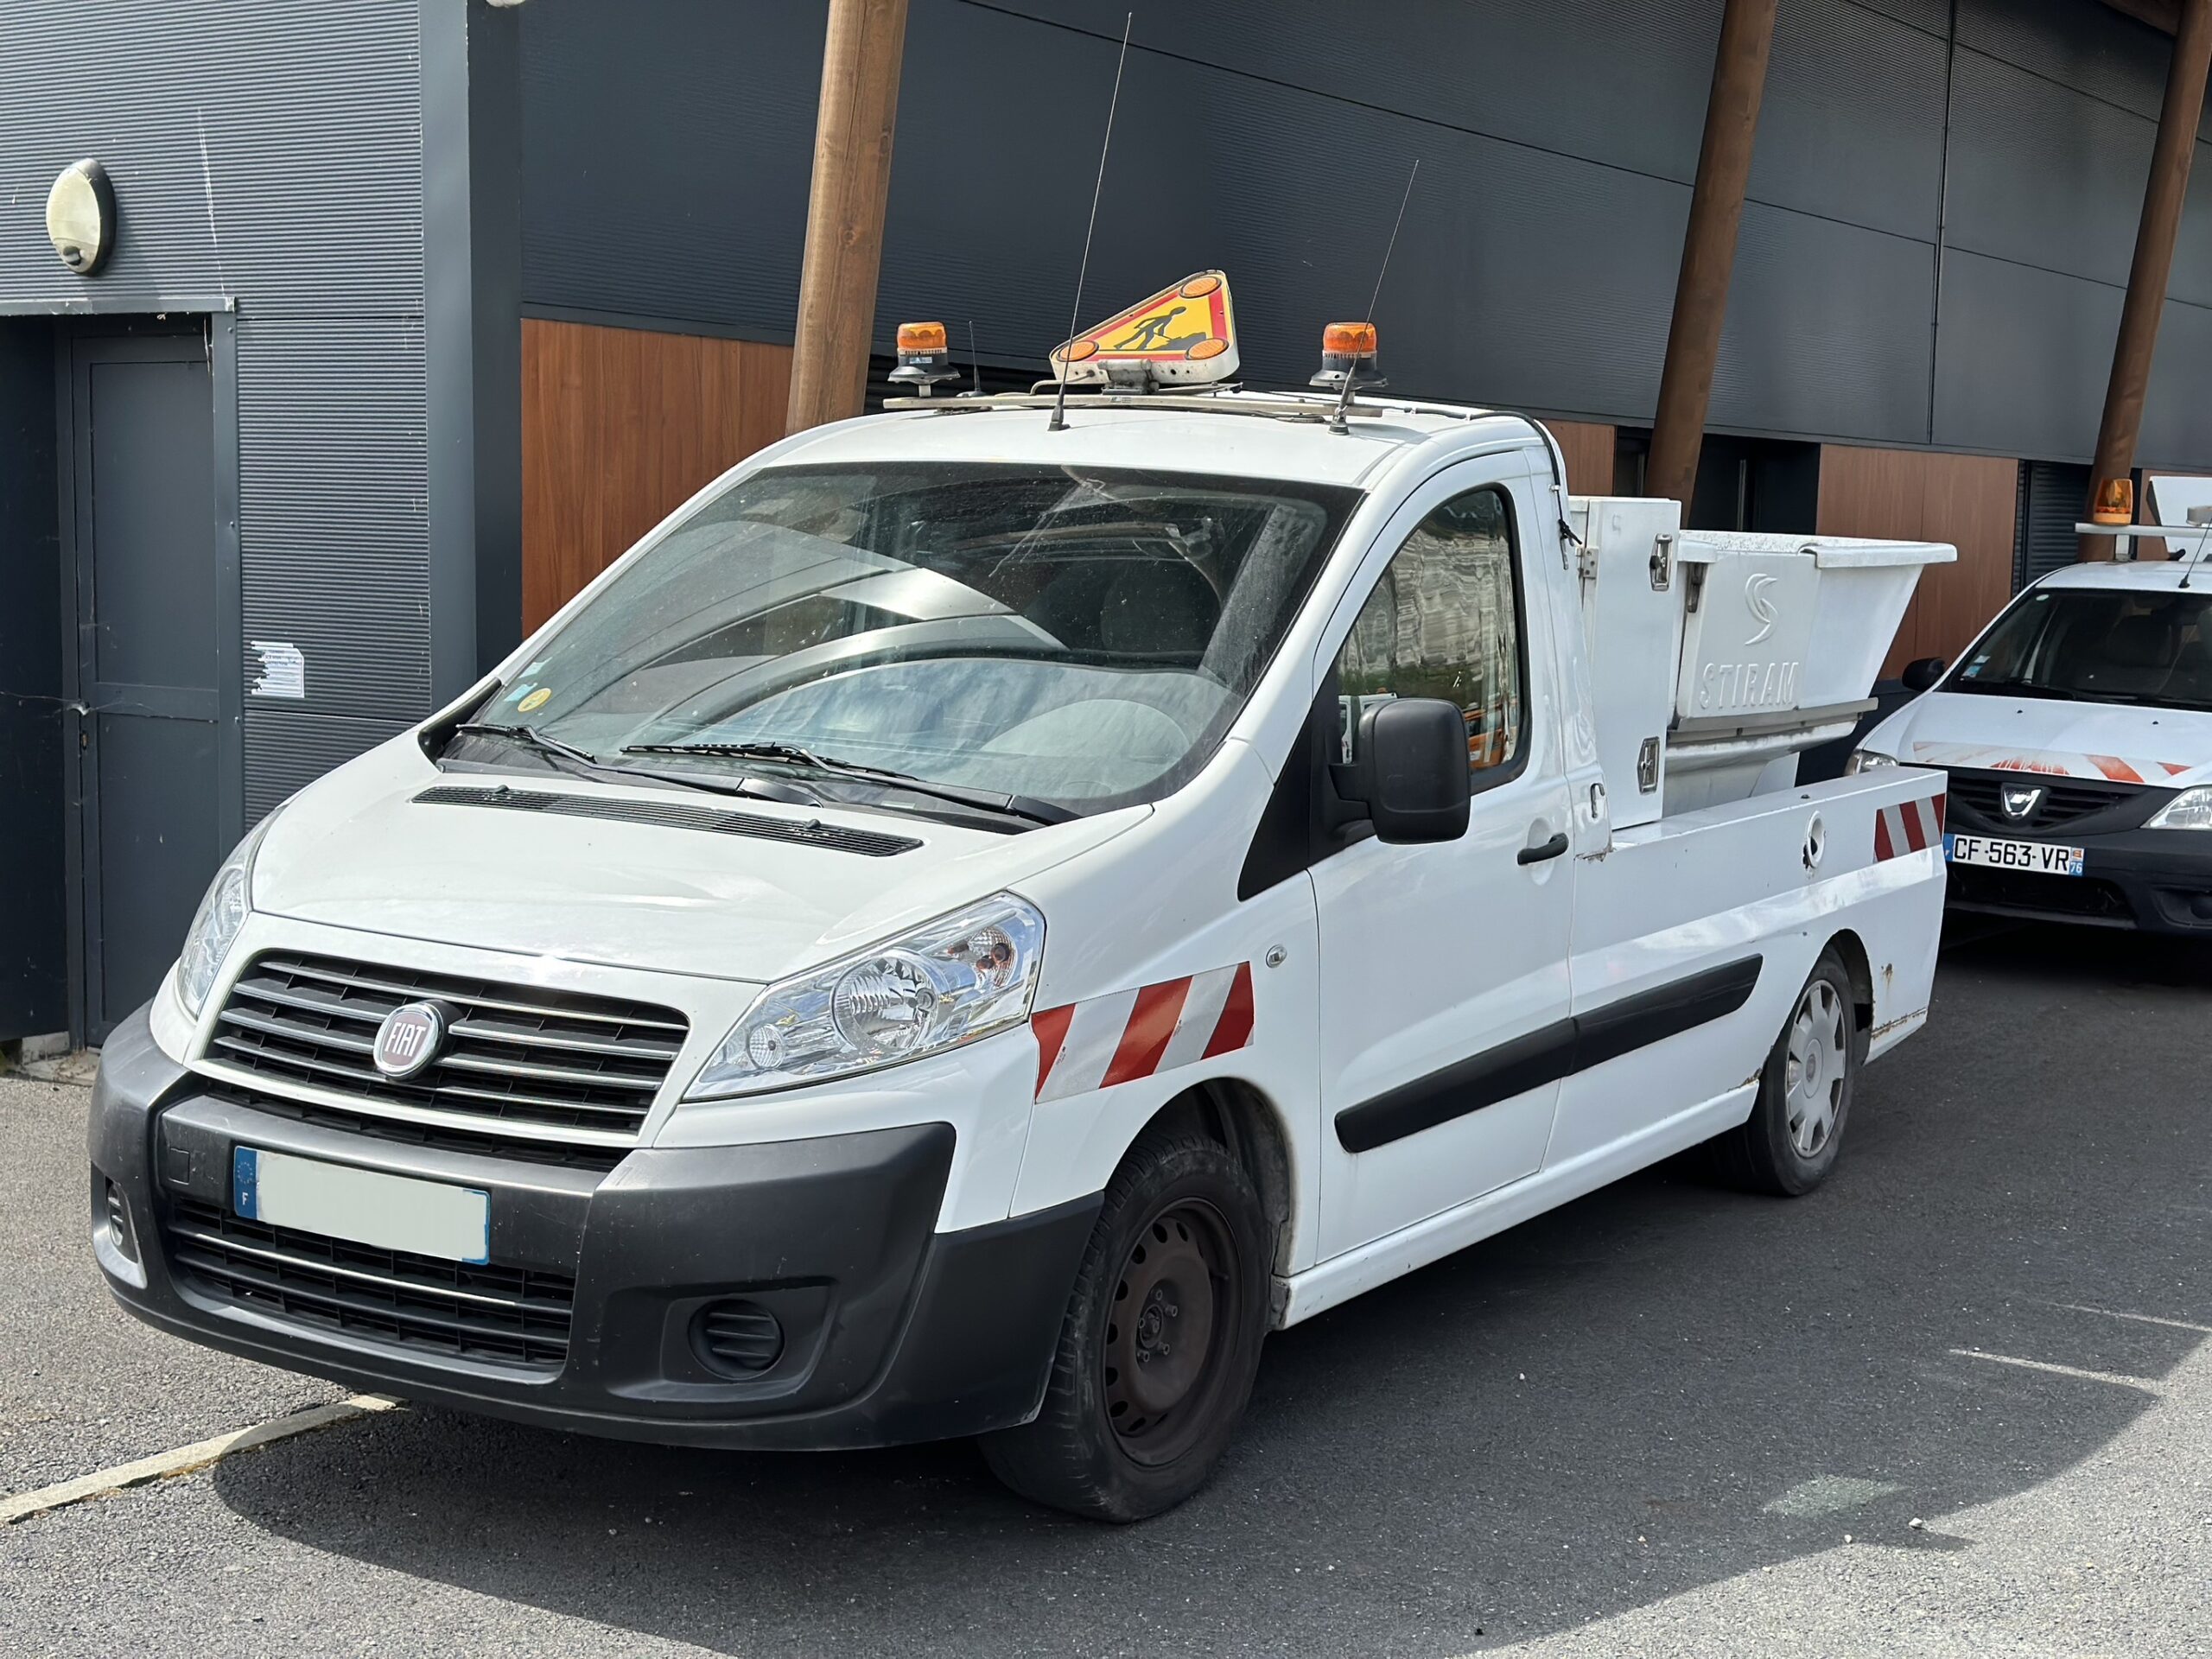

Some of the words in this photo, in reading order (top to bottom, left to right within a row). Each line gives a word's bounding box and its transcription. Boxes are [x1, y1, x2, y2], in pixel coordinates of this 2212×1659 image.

[1700, 662, 1800, 710] STIRAM
[2070, 861, 2083, 874] 76
[385, 1022, 427, 1057] FIAT
[242, 1192, 249, 1205] F
